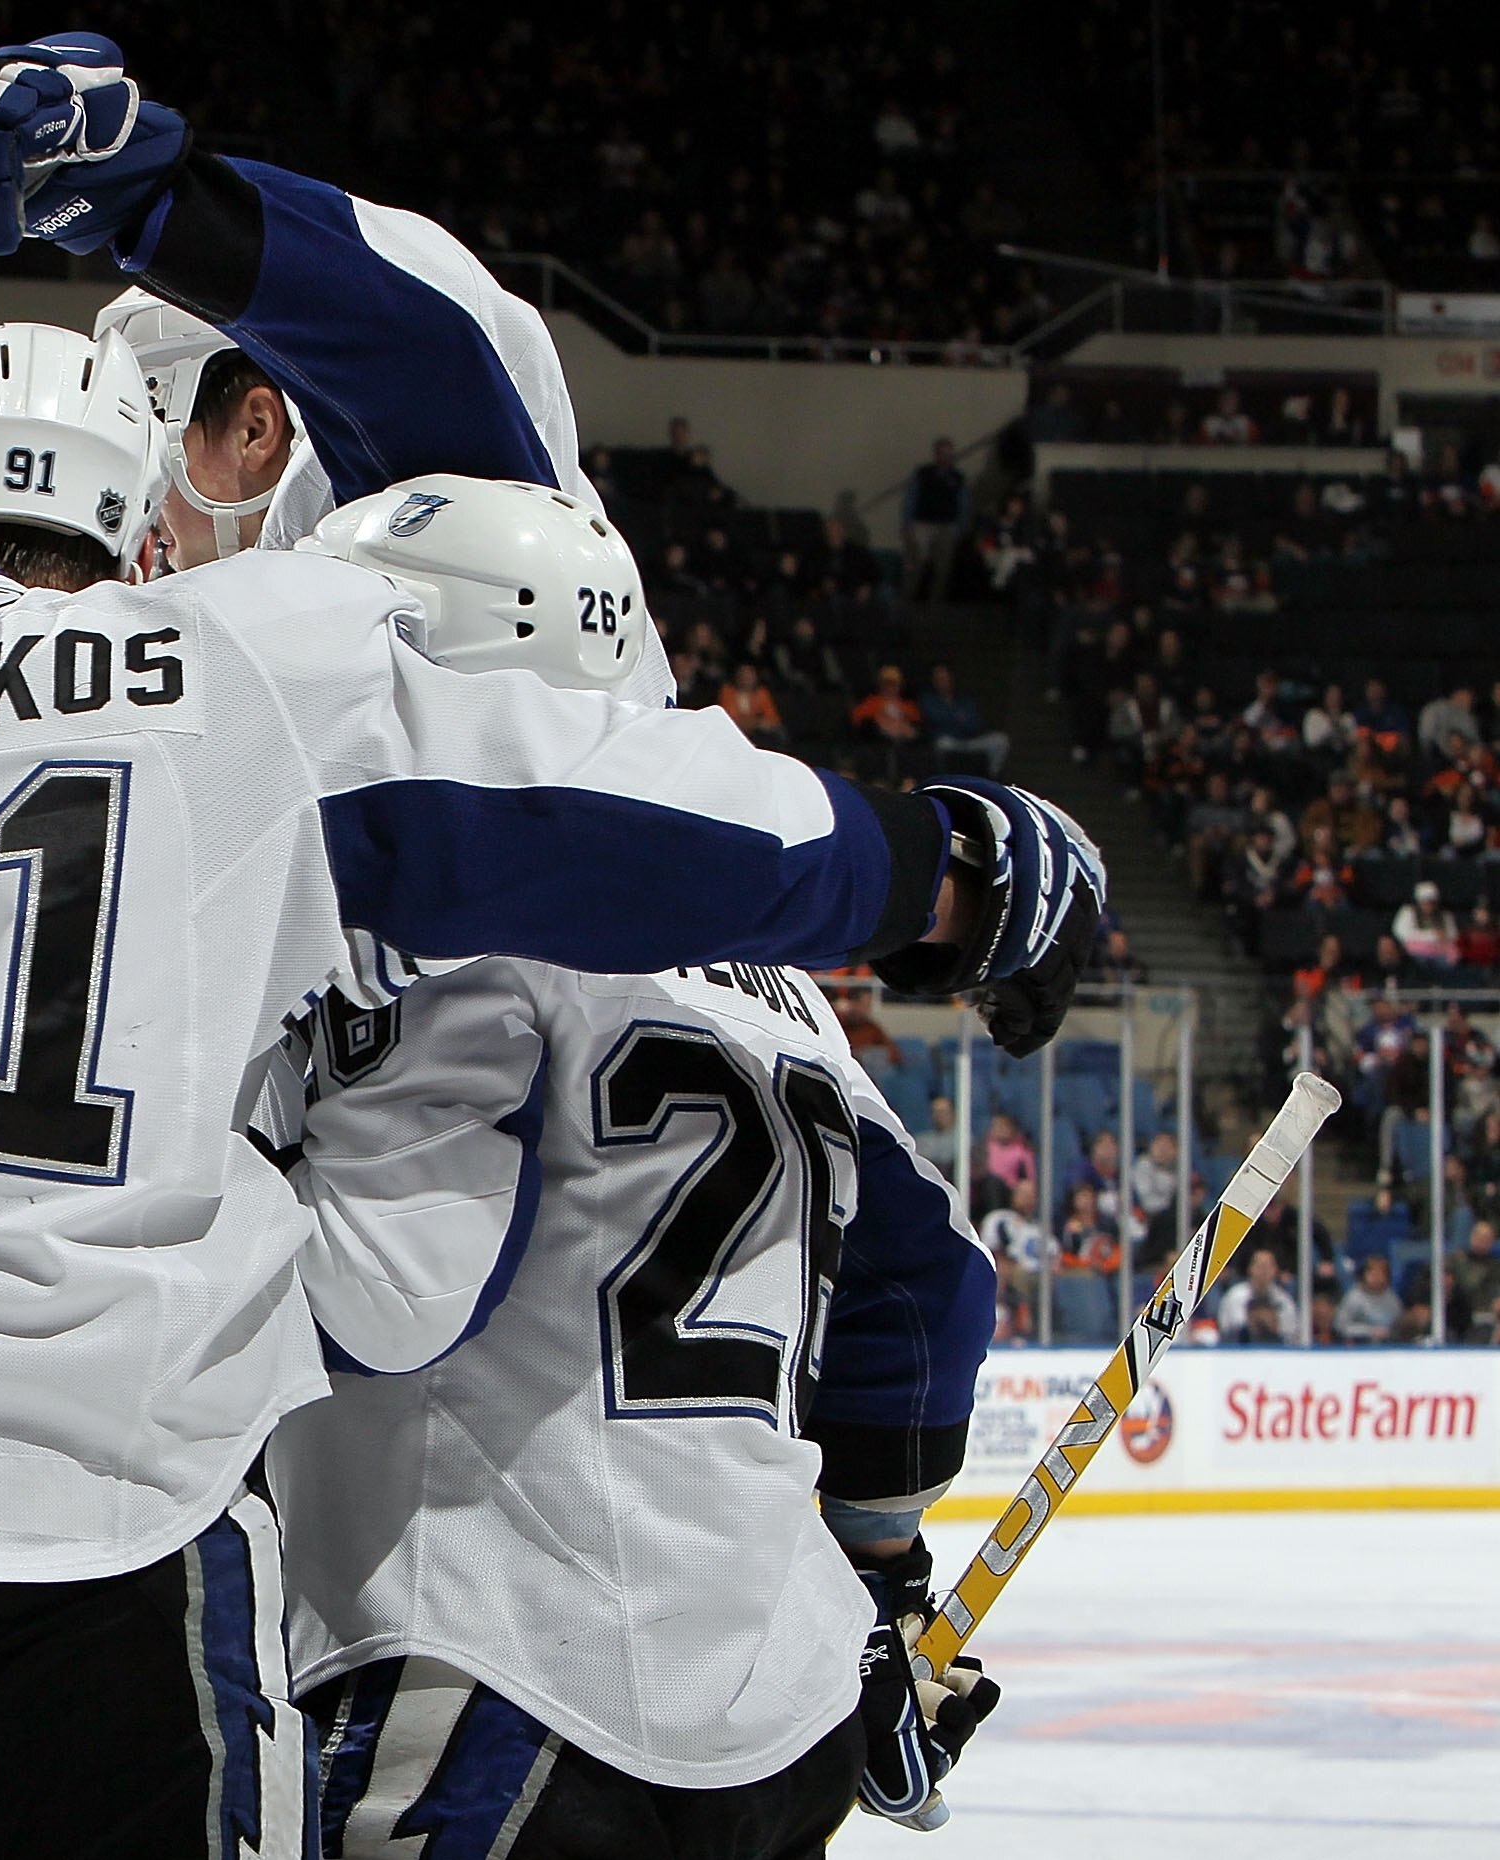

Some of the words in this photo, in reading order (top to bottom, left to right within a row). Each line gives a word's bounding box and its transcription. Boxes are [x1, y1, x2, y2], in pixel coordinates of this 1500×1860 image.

[35, 198, 93, 234] Reebok
[3, 446, 56, 497] 91
[577, 586, 617, 637] 26
[590, 1019, 859, 1440] 26
[1223, 1379, 1341, 1441] State
[1348, 1379, 1477, 1439] Farm
